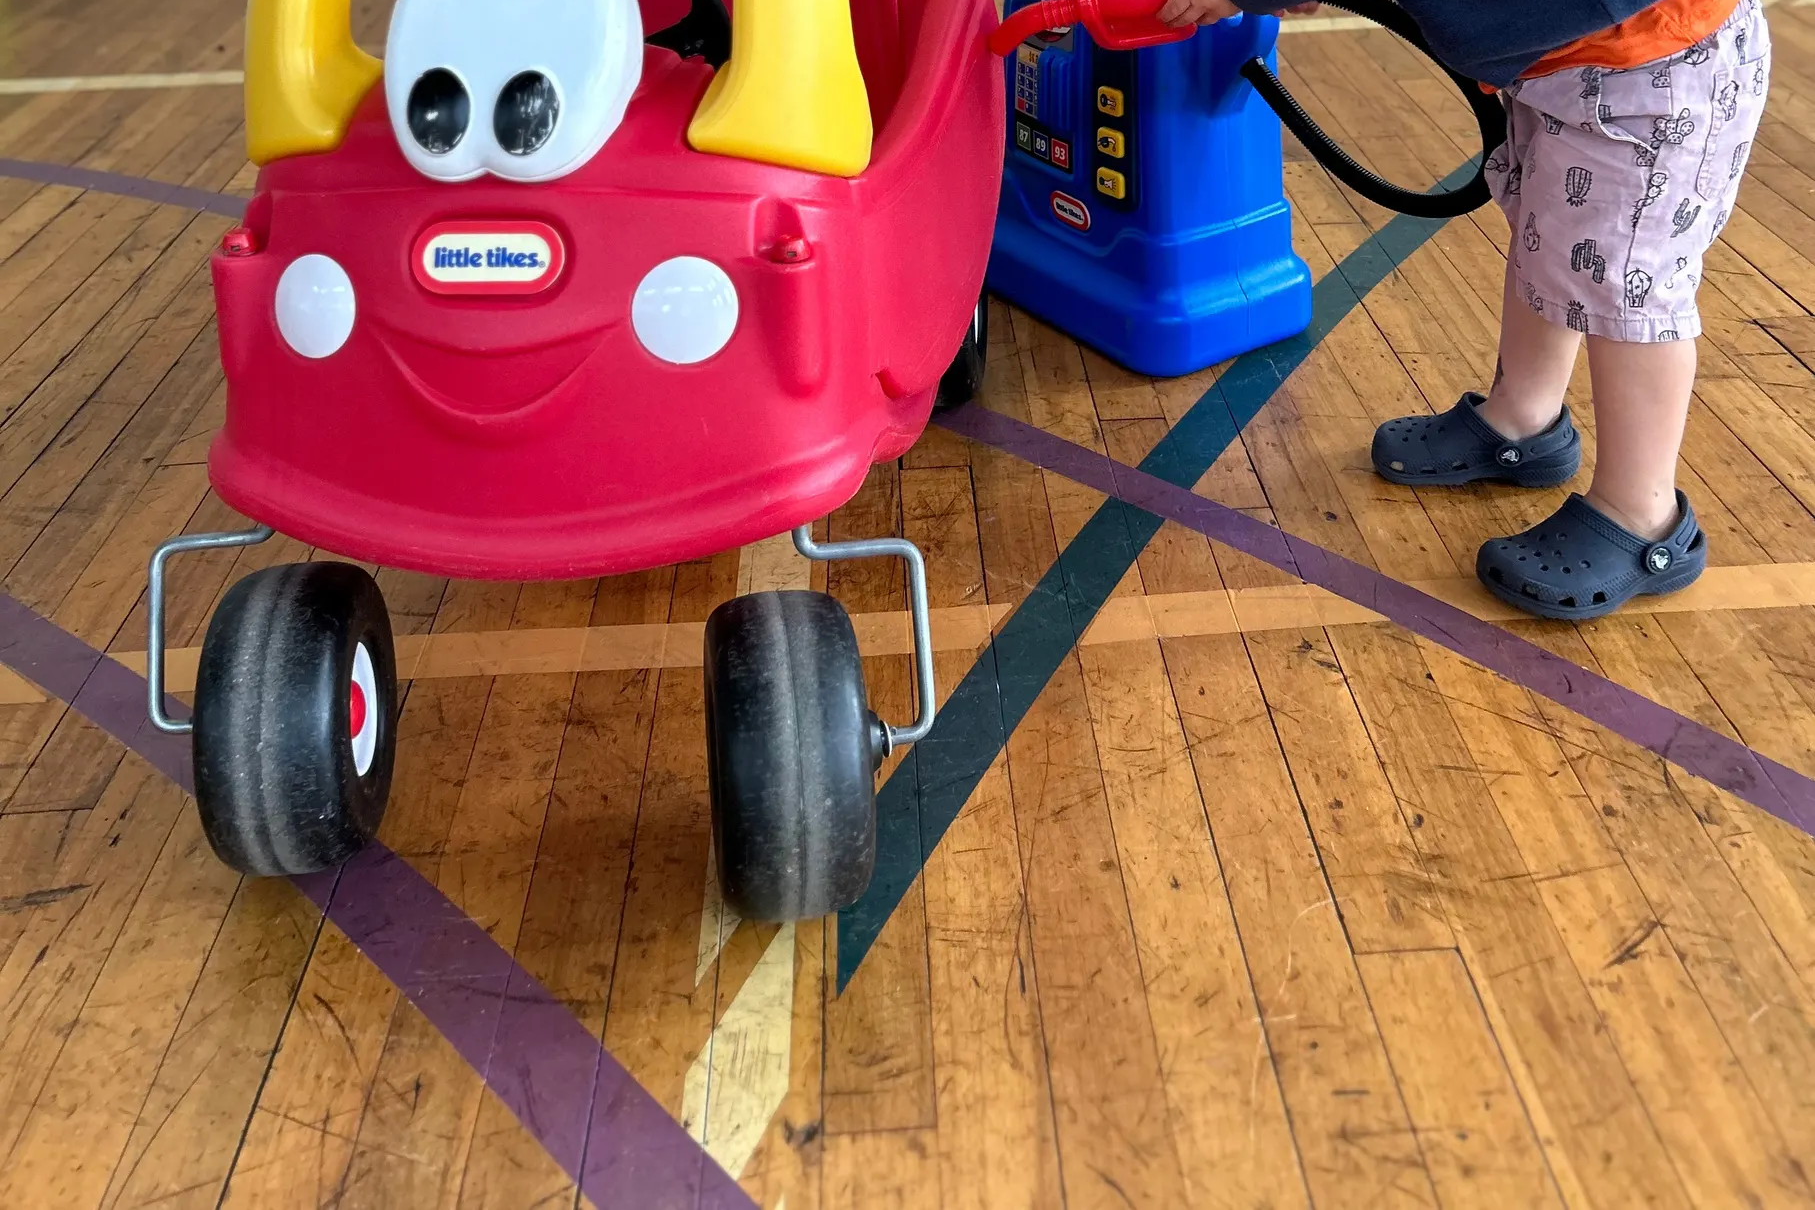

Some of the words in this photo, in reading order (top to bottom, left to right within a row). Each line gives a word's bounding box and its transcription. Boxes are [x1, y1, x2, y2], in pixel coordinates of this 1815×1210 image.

[1019, 129, 1029, 143] 87
[1035, 137, 1047, 152] 89
[1054, 145, 1066, 161] 93
[434, 246, 483, 269] little
